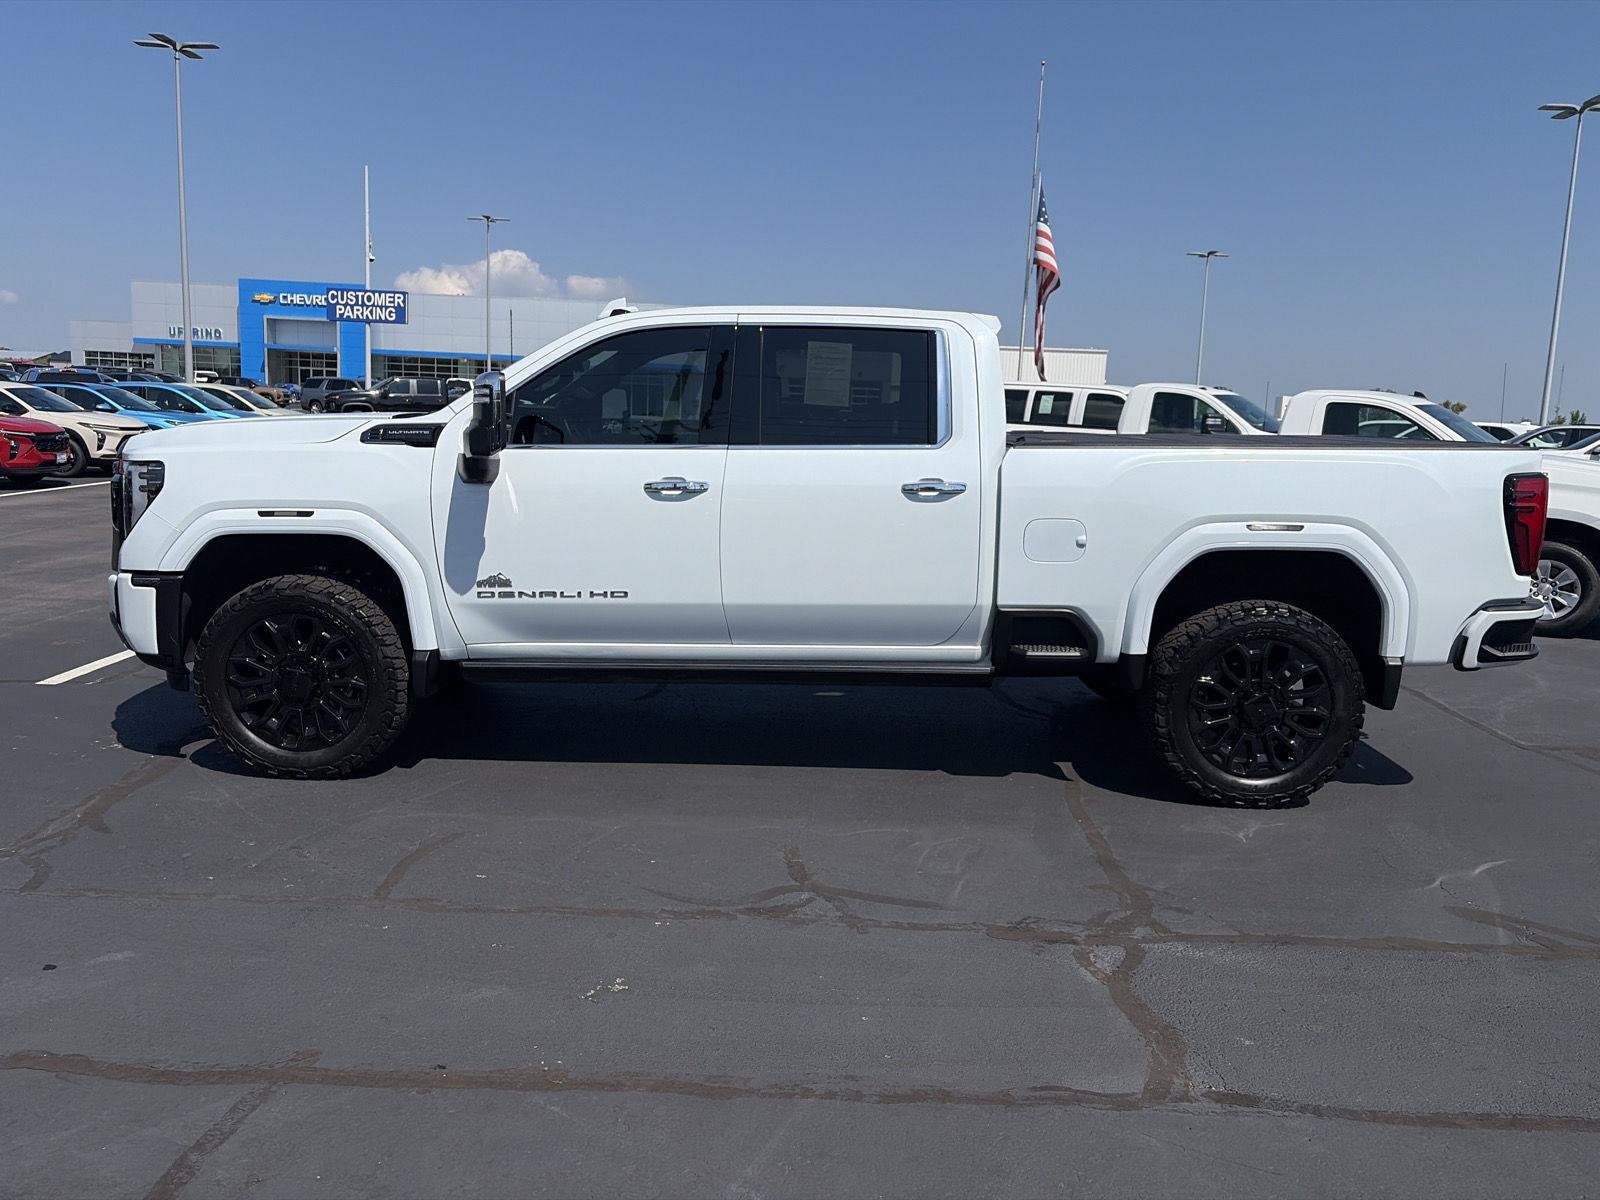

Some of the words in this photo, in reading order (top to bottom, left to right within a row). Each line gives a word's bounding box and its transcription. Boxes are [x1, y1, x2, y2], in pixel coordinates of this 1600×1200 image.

[328, 290, 404, 307] CUSTOMER
[336, 305, 396, 321] PARKING
[169, 326, 222, 340] UFRING
[476, 590, 582, 599] DENALI
[589, 590, 629, 599] HD
